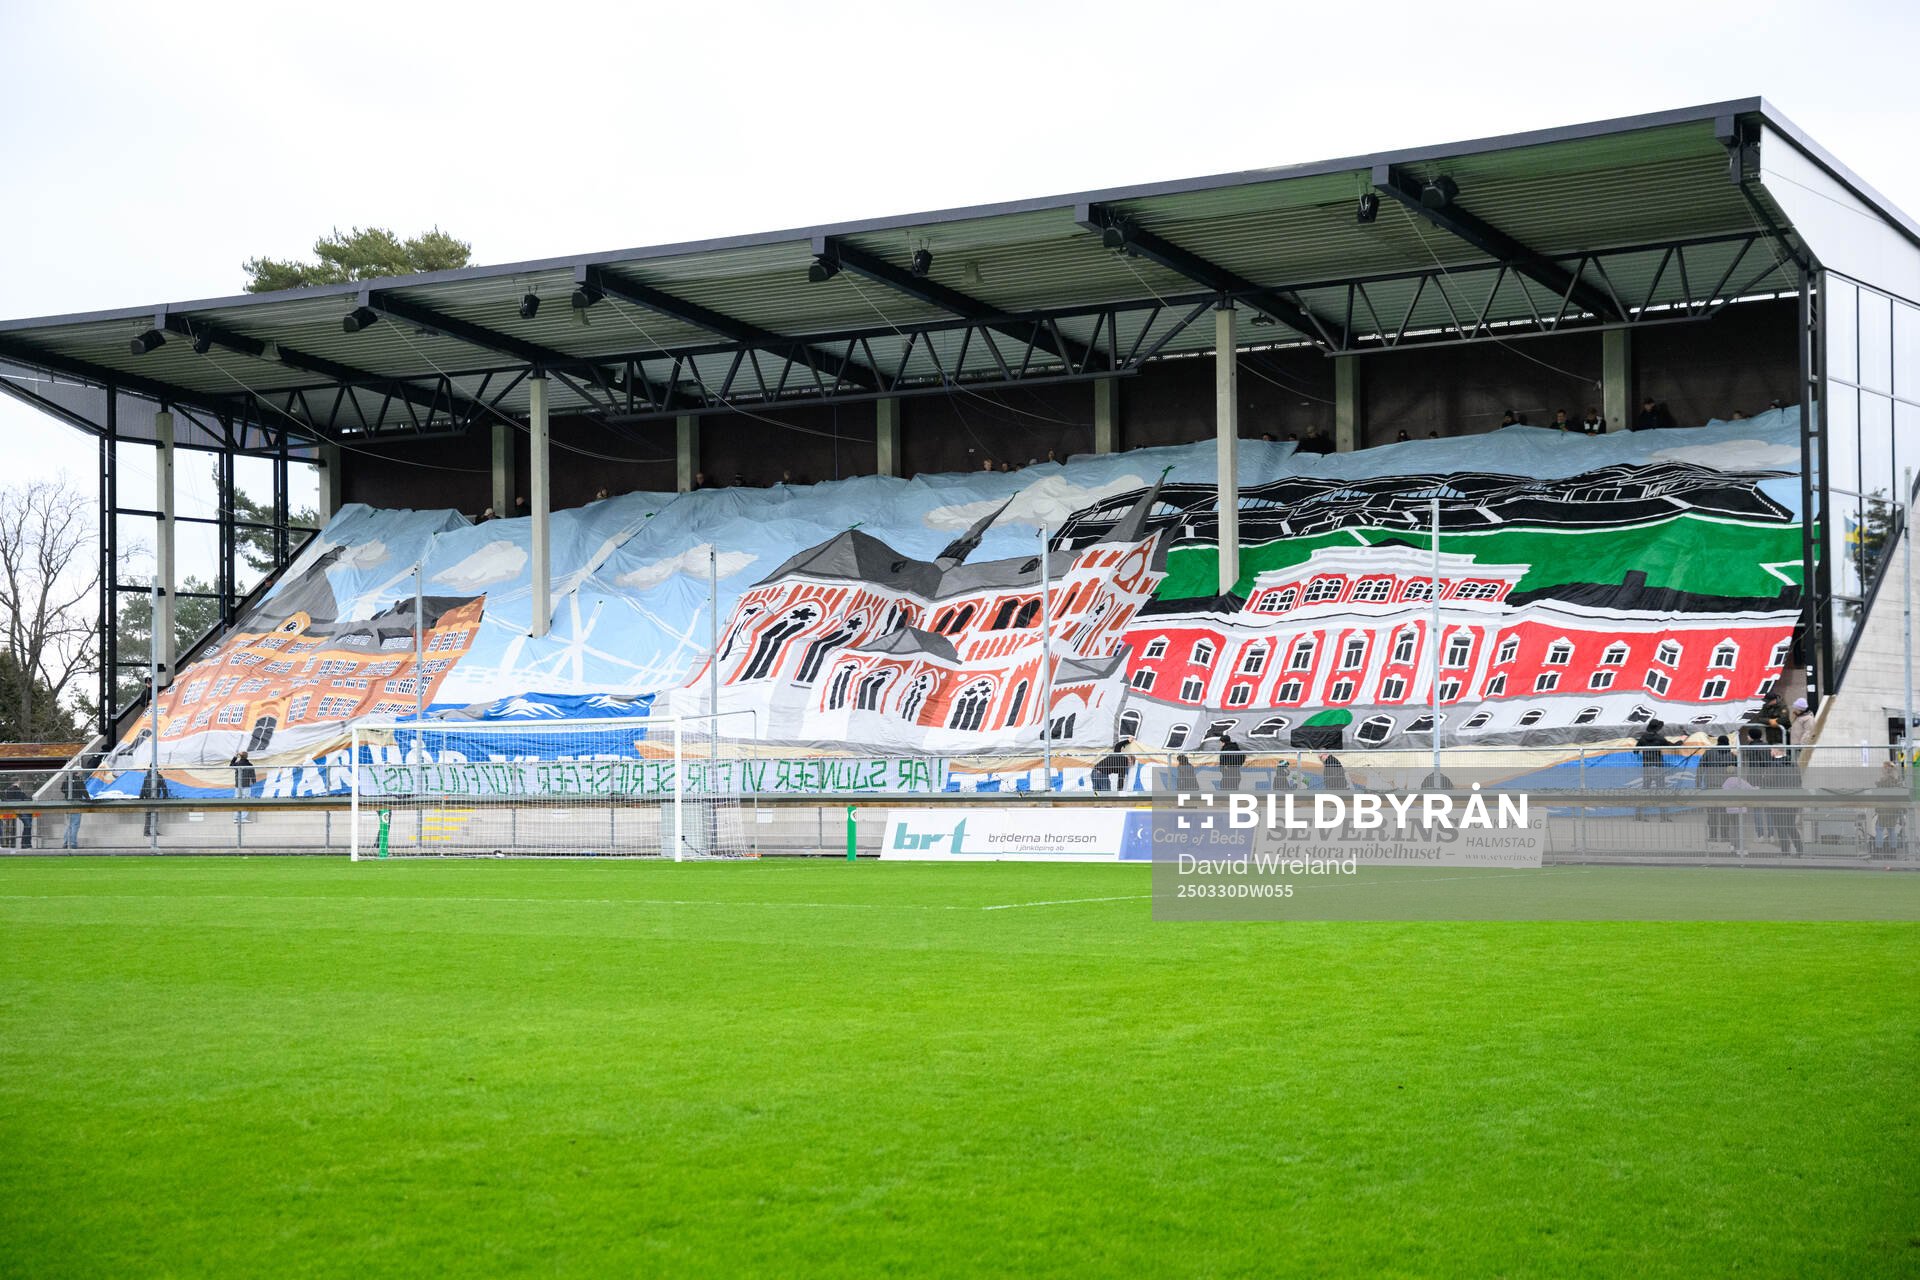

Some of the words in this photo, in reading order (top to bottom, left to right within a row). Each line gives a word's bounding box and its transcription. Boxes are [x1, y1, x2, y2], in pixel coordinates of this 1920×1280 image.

[988, 832, 1041, 843] bröderna
[1044, 832, 1097, 843] thorsson
[1153, 828, 1188, 844] Care
[1192, 833, 1205, 846] of
[1209, 829, 1246, 845] Beds
[1266, 817, 1460, 843] SEVERINS
[1466, 837, 1536, 848] HALMSTAD
[1276, 843, 1300, 858] det
[1304, 846, 1344, 859] stora
[1349, 843, 1442, 860] möbelhuset
